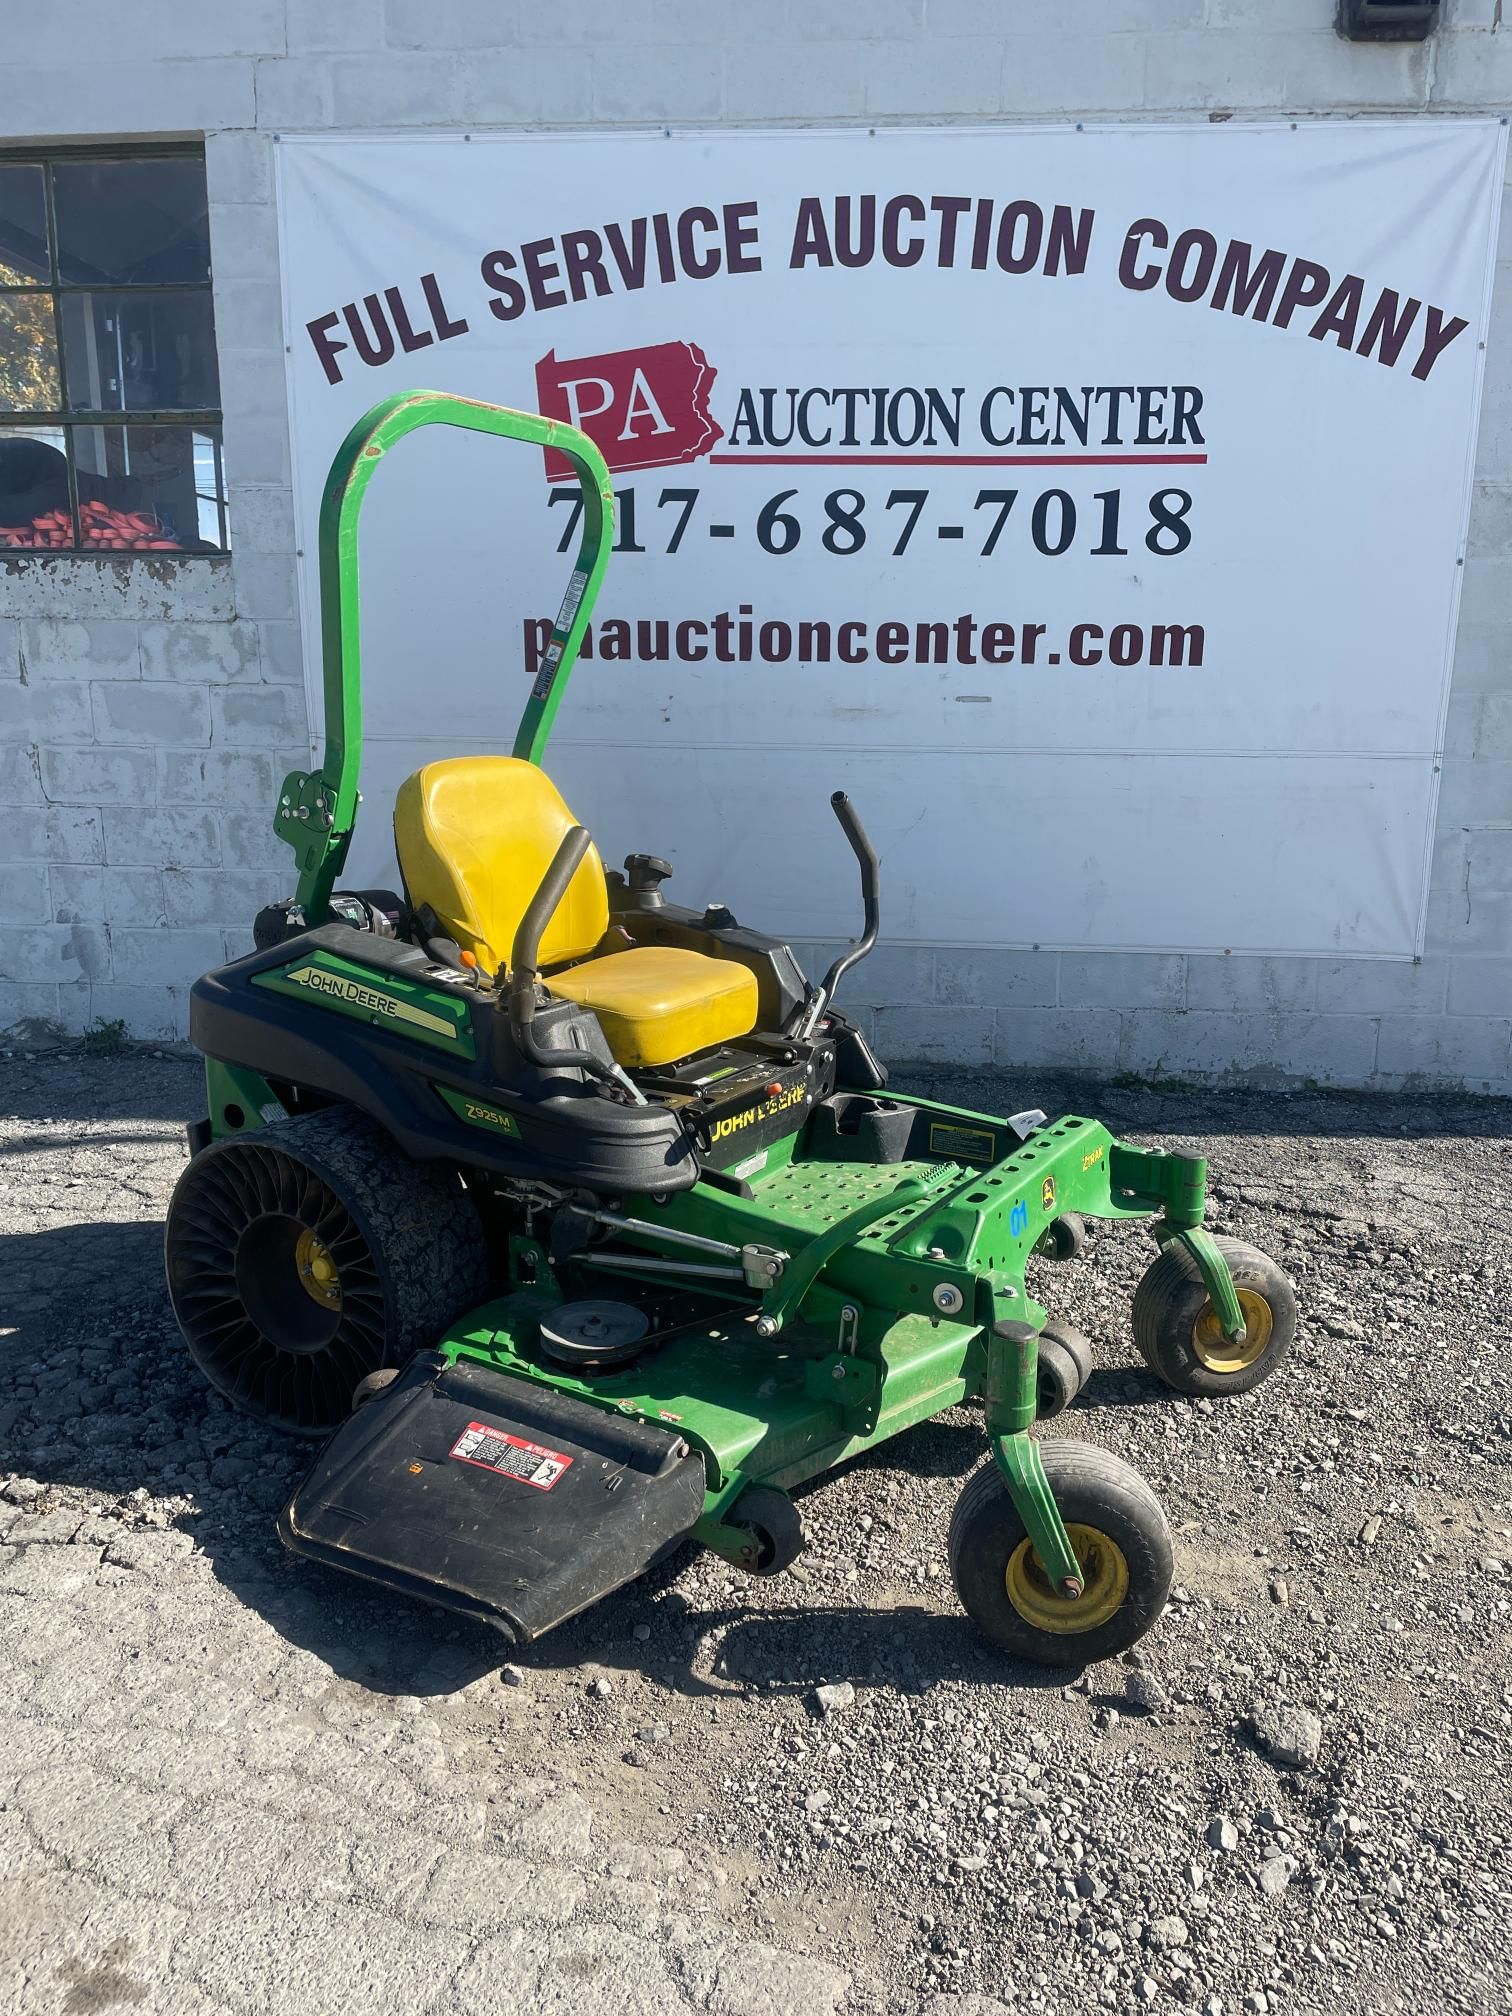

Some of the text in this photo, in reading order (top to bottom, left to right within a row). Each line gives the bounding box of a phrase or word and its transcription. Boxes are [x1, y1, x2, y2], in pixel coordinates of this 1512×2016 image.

[306, 194, 1471, 386] FULL SERVICE AUCTION COMPANY
[557, 367, 676, 442] PA
[728, 385, 1206, 448] AUCTION CENTER
[547, 487, 1193, 557] 717-687-7018
[300, 971, 397, 1015] JOHN DEERE
[712, 1108, 755, 1142] JOHN
[486, 1428, 509, 1441] DANGER
[533, 1446, 558, 1459] PELIGRO
